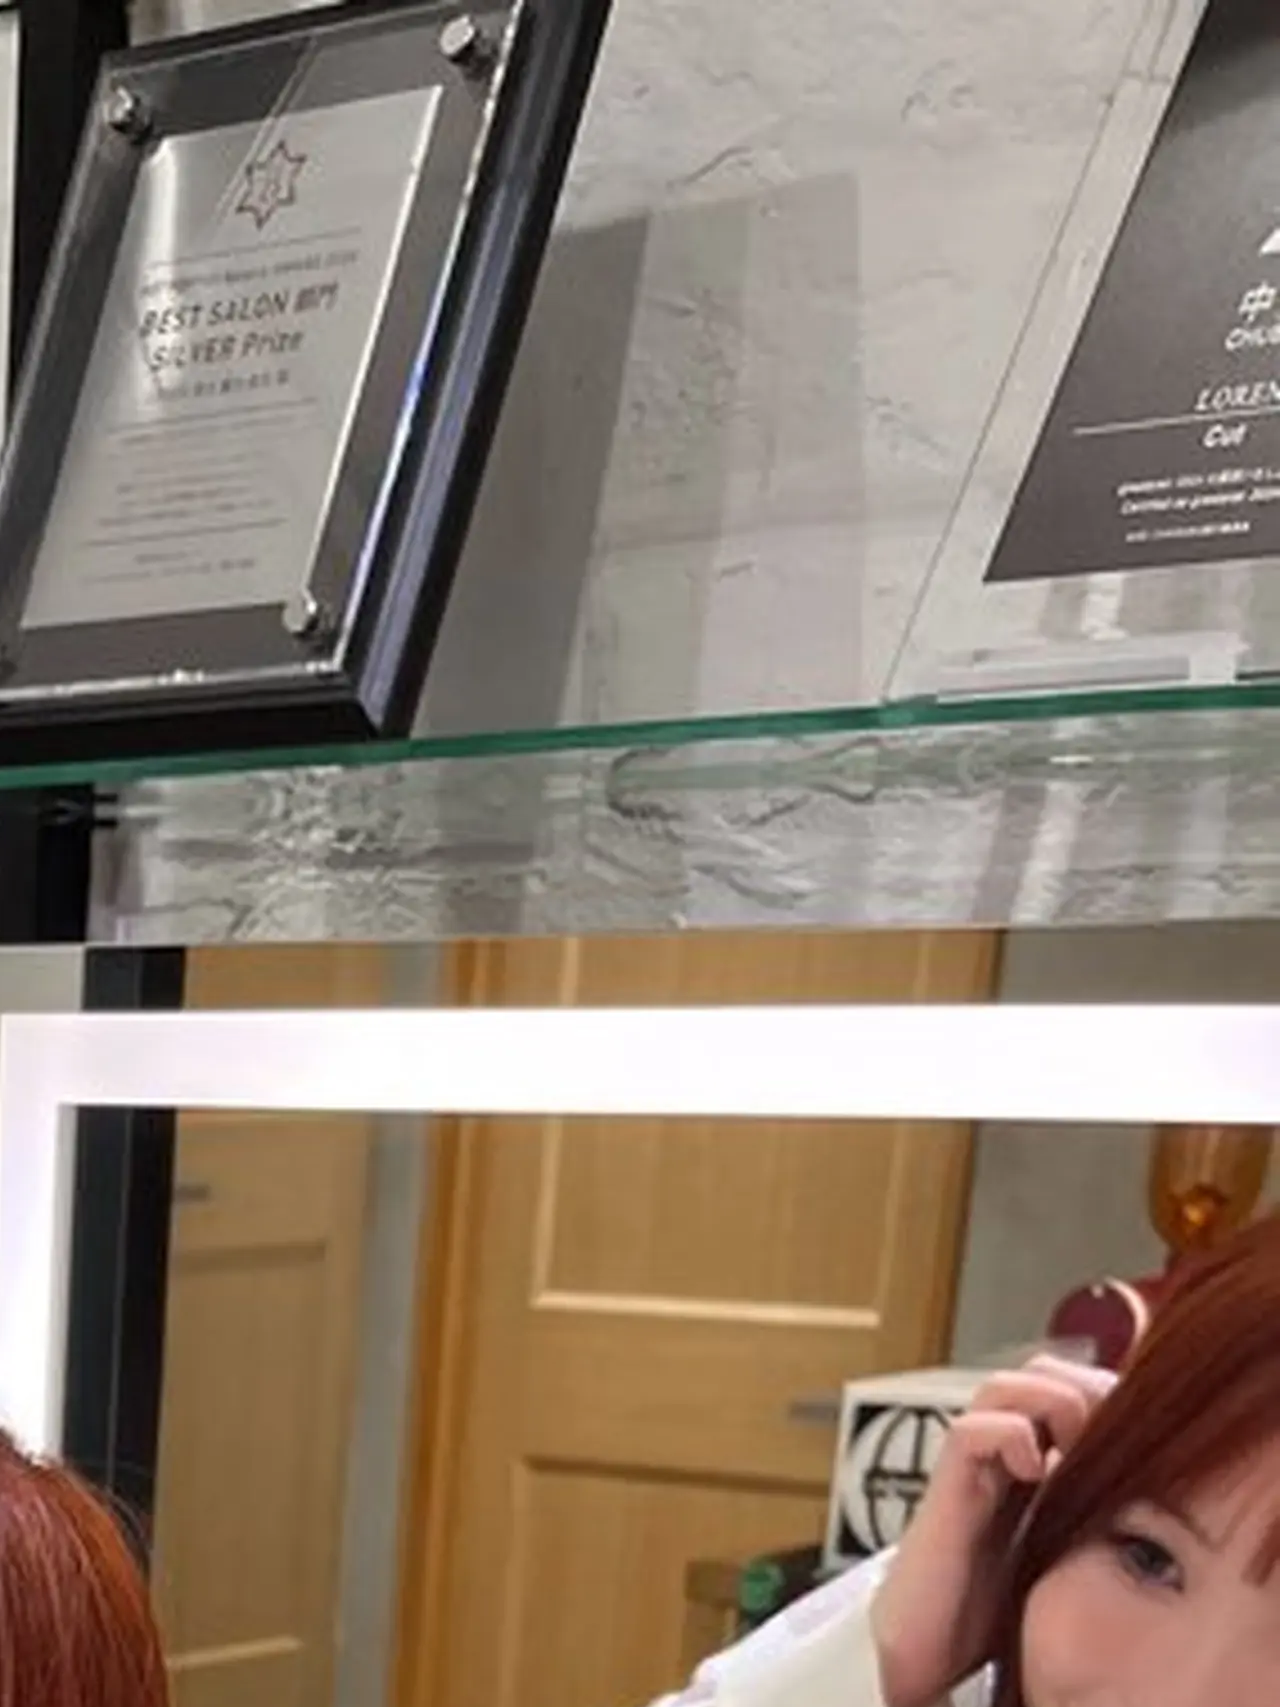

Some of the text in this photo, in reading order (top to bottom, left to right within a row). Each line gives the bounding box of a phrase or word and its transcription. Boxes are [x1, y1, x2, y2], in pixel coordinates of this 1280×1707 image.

[140, 304, 203, 338] BEST
[206, 290, 290, 326] SALON
[149, 331, 305, 372] SILVER Prize
